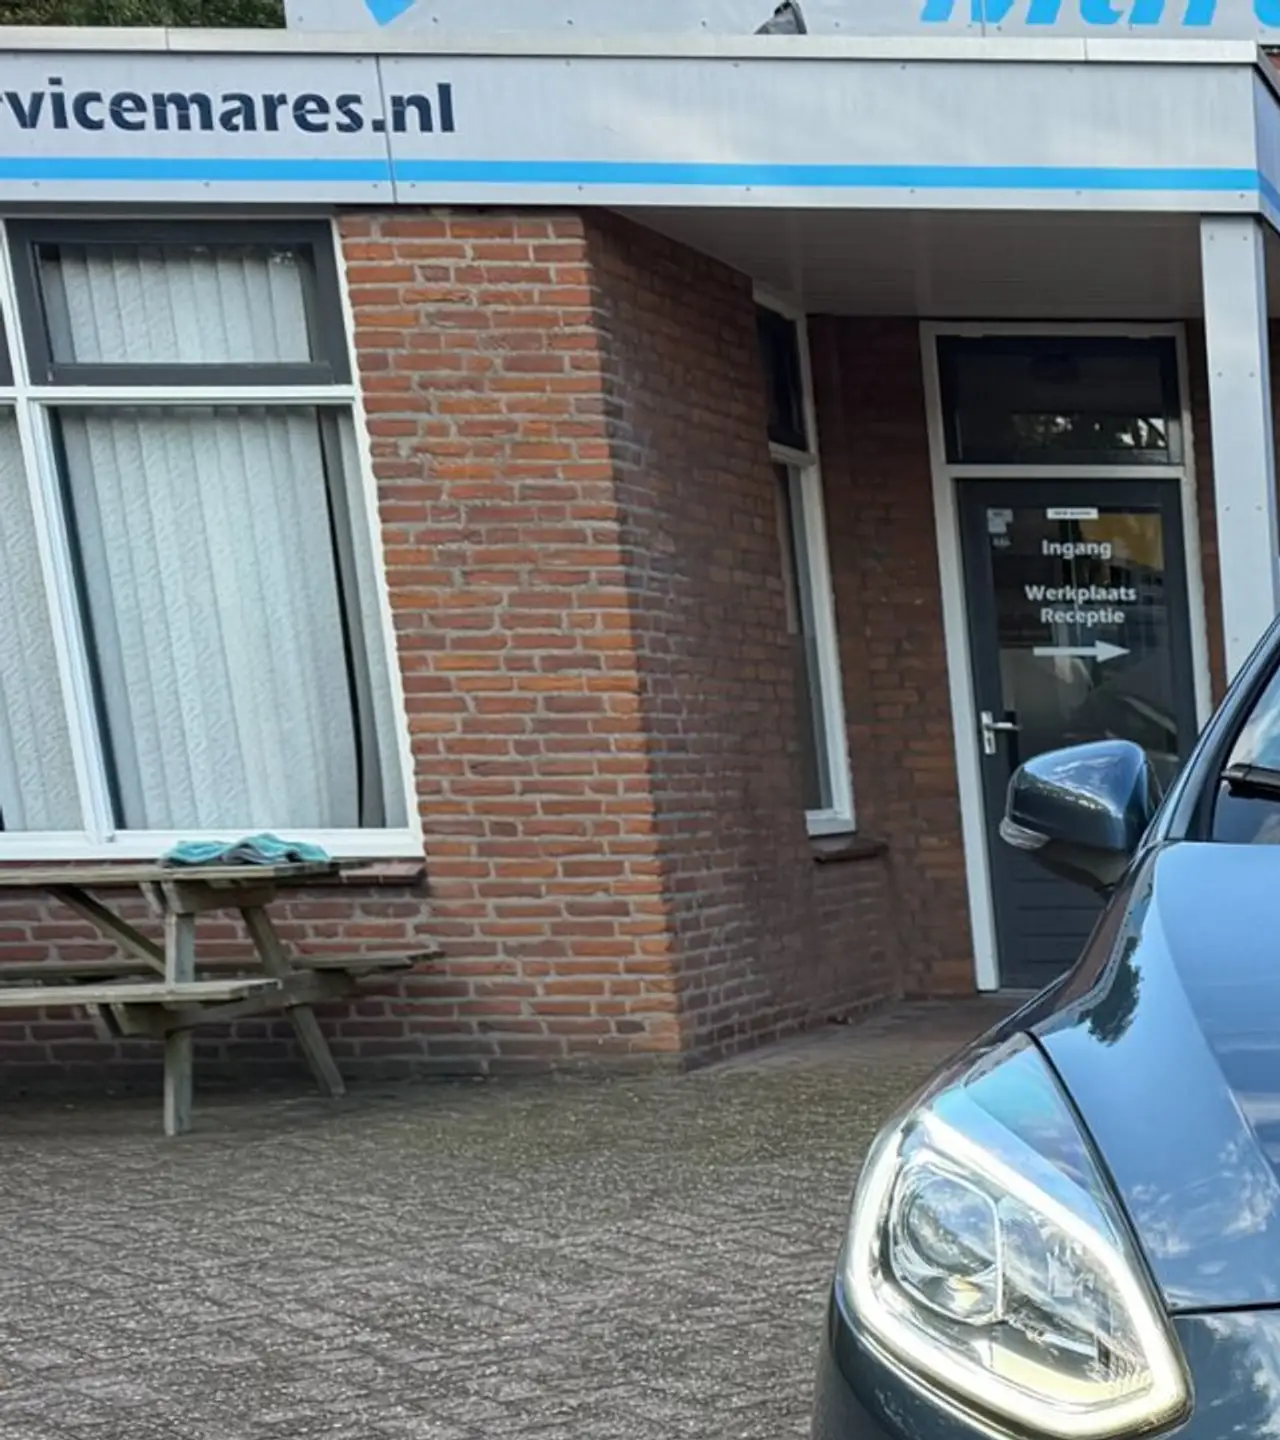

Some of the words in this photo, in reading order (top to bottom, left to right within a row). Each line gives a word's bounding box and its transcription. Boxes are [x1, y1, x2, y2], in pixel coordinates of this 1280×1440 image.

[0, 77, 455, 133] vicemares.nl
[1042, 539, 1112, 559] Ingang
[1024, 584, 1137, 604] Werkplaats
[1040, 607, 1125, 627] Receptie
